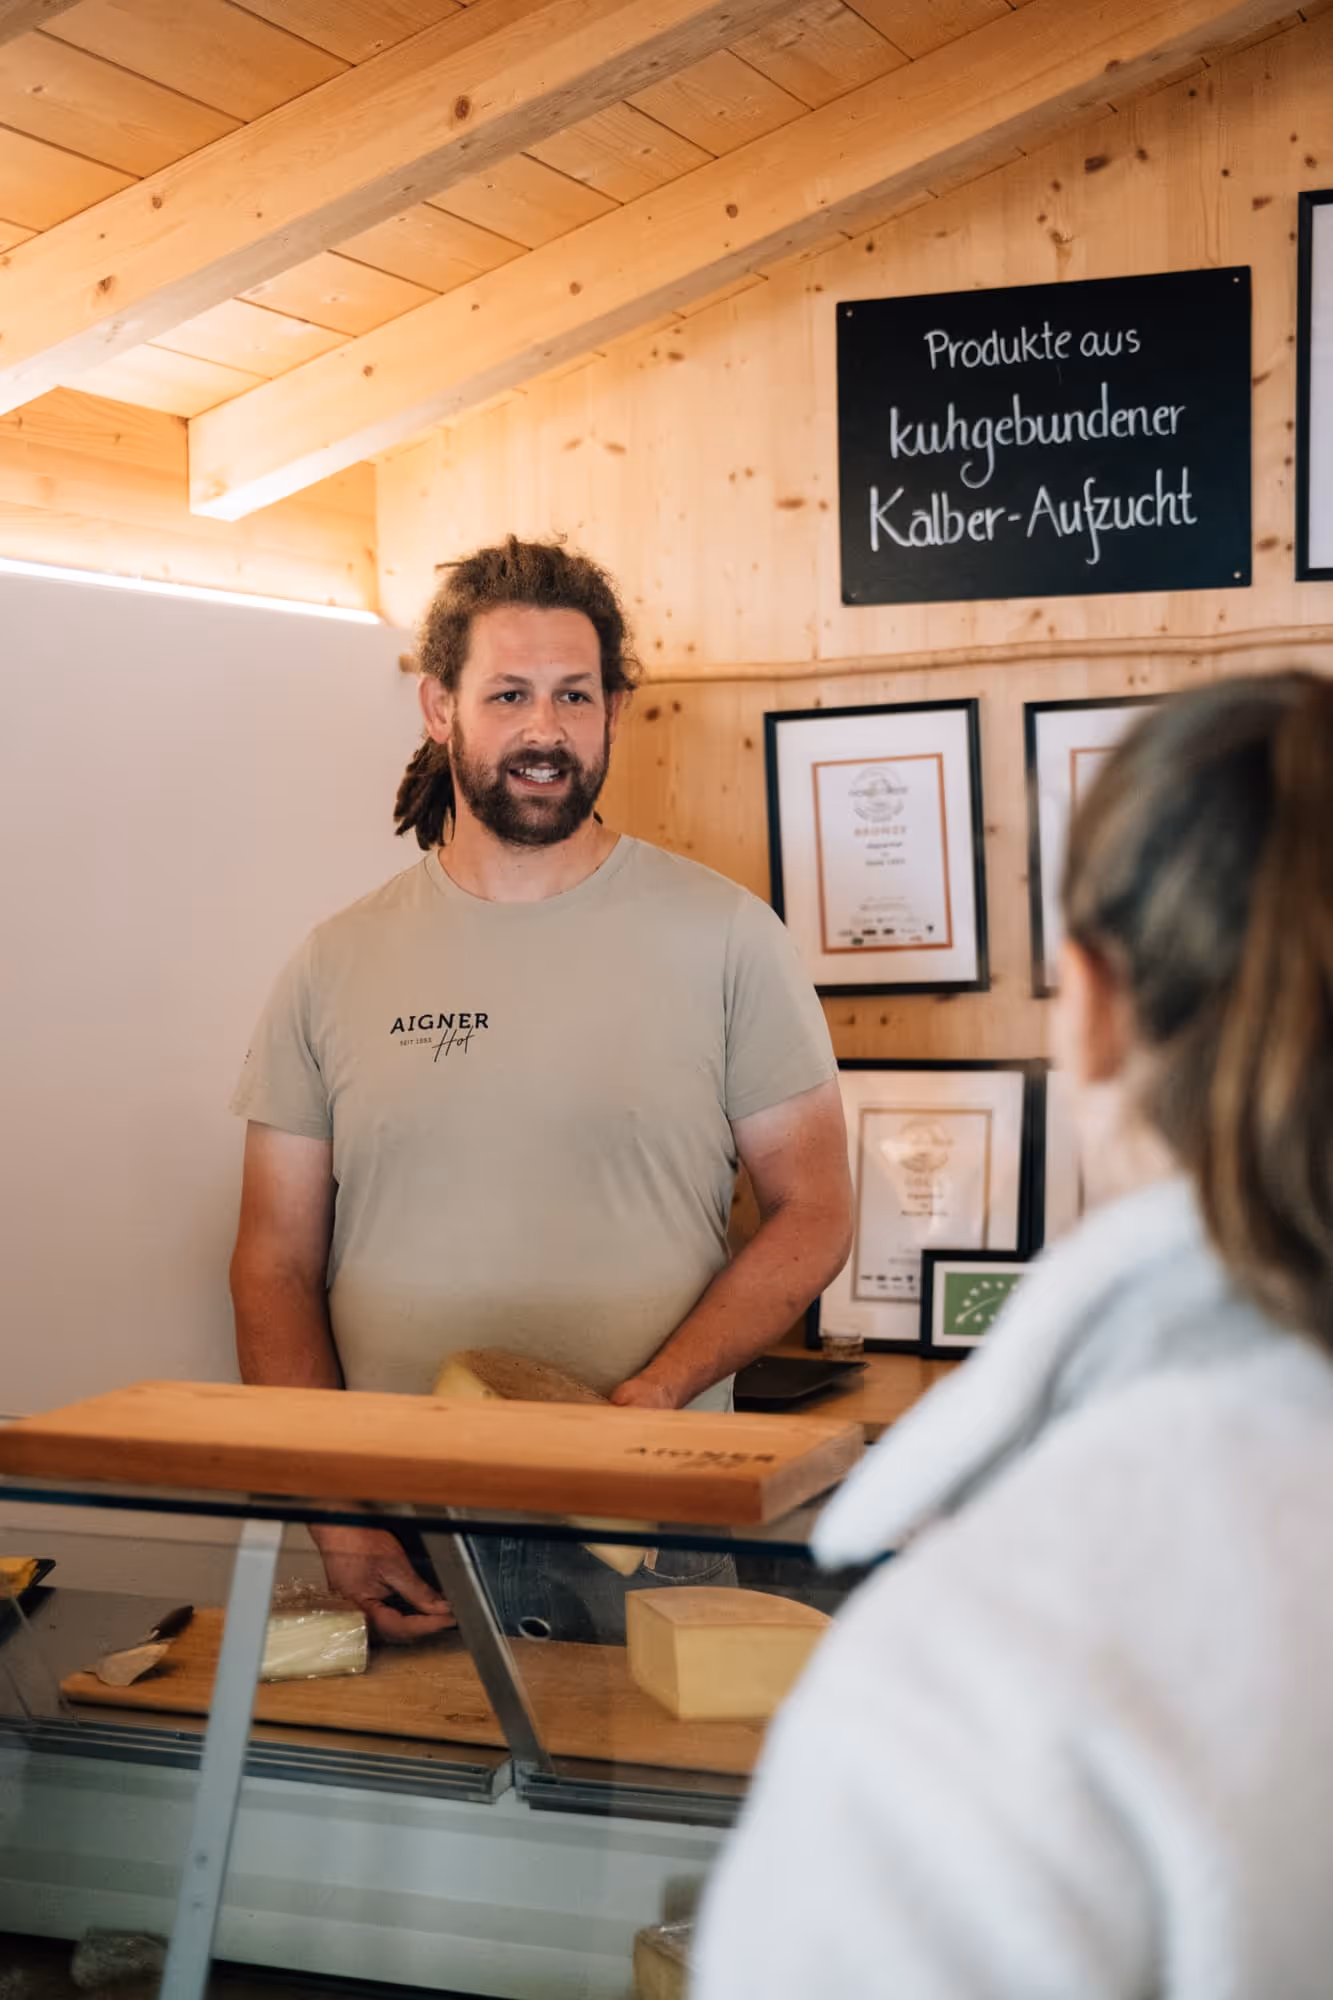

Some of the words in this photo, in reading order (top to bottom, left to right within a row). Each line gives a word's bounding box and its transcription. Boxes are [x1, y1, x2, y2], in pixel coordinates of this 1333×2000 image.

[924, 321, 1071, 370] Produkte
[1079, 326, 1141, 357] aus
[889, 381, 1186, 488] kuhgebundener
[390, 1013, 489, 1035] AIGNER
